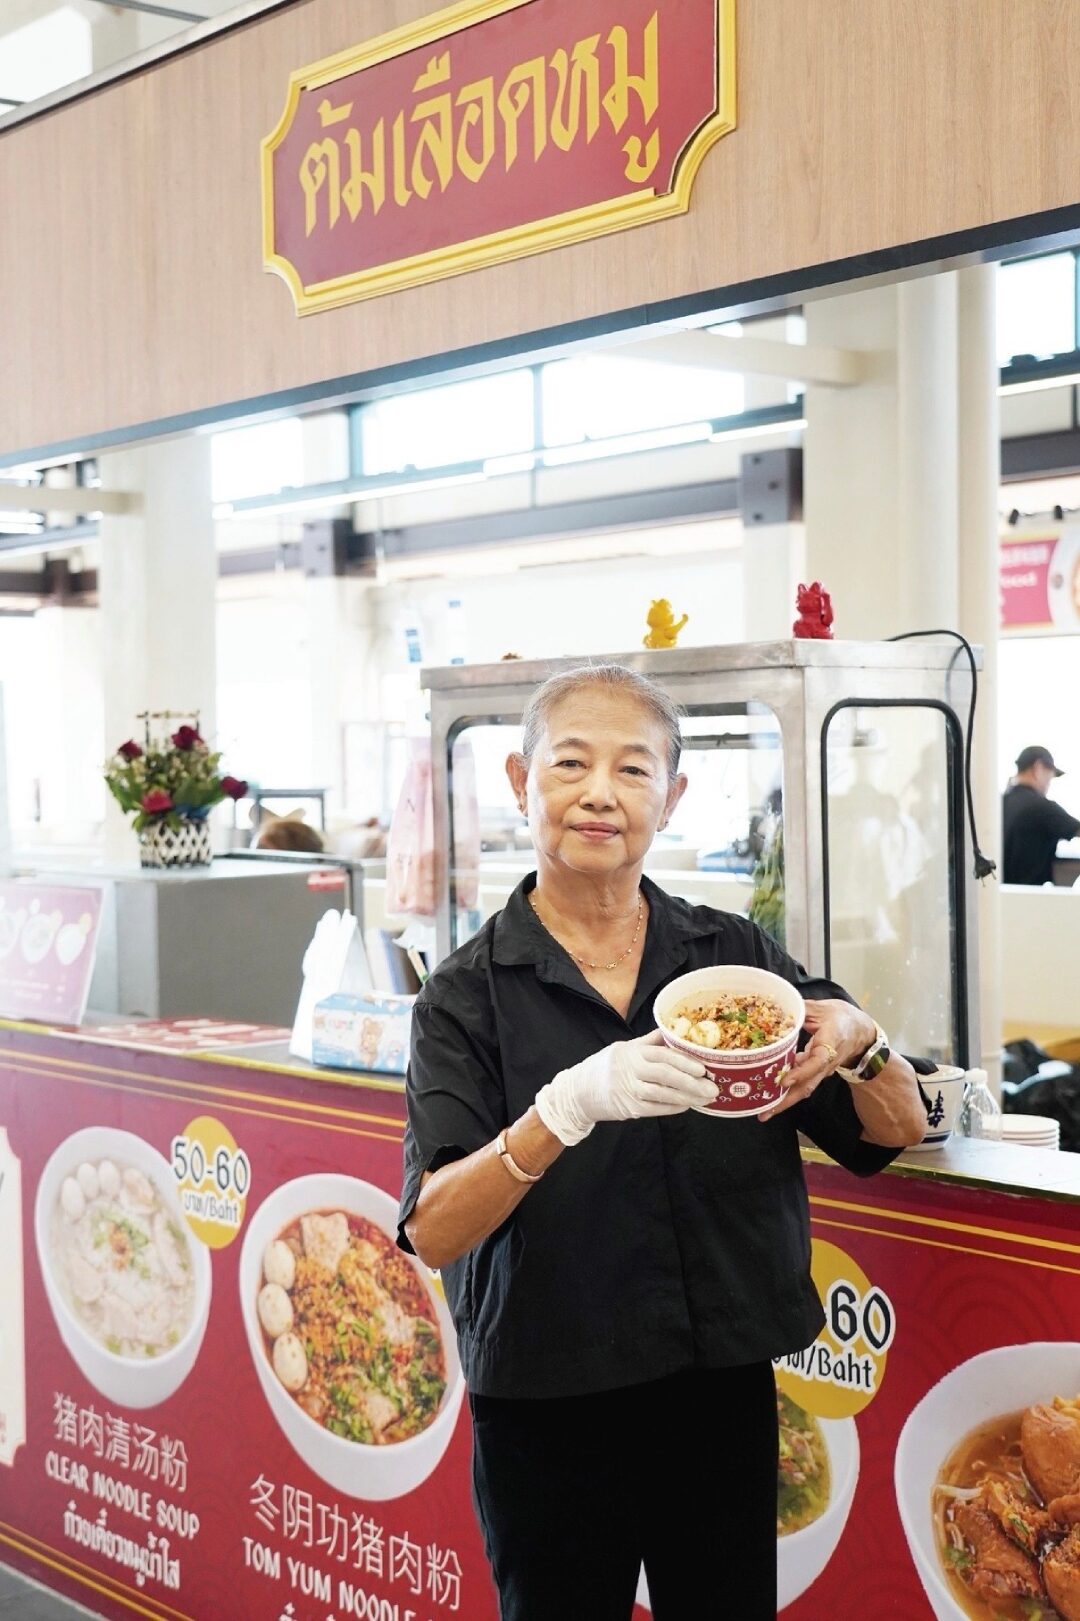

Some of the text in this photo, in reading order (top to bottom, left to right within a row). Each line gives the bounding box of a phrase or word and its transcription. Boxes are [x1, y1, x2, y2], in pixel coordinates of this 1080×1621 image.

[299, 10, 660, 239] ต้มเลือดหมู
[174, 1142, 248, 1194] 50-60
[825, 1285, 891, 1349] 60
[53, 1391, 188, 1492] 猪肉清汤粉
[45, 1450, 200, 1540] CLEAR NOODLE SOUP
[242, 1536, 281, 1579] TOM
[286, 1556, 331, 1604] YUM
[250, 1473, 463, 1611] 冬阴功猪肉粉
